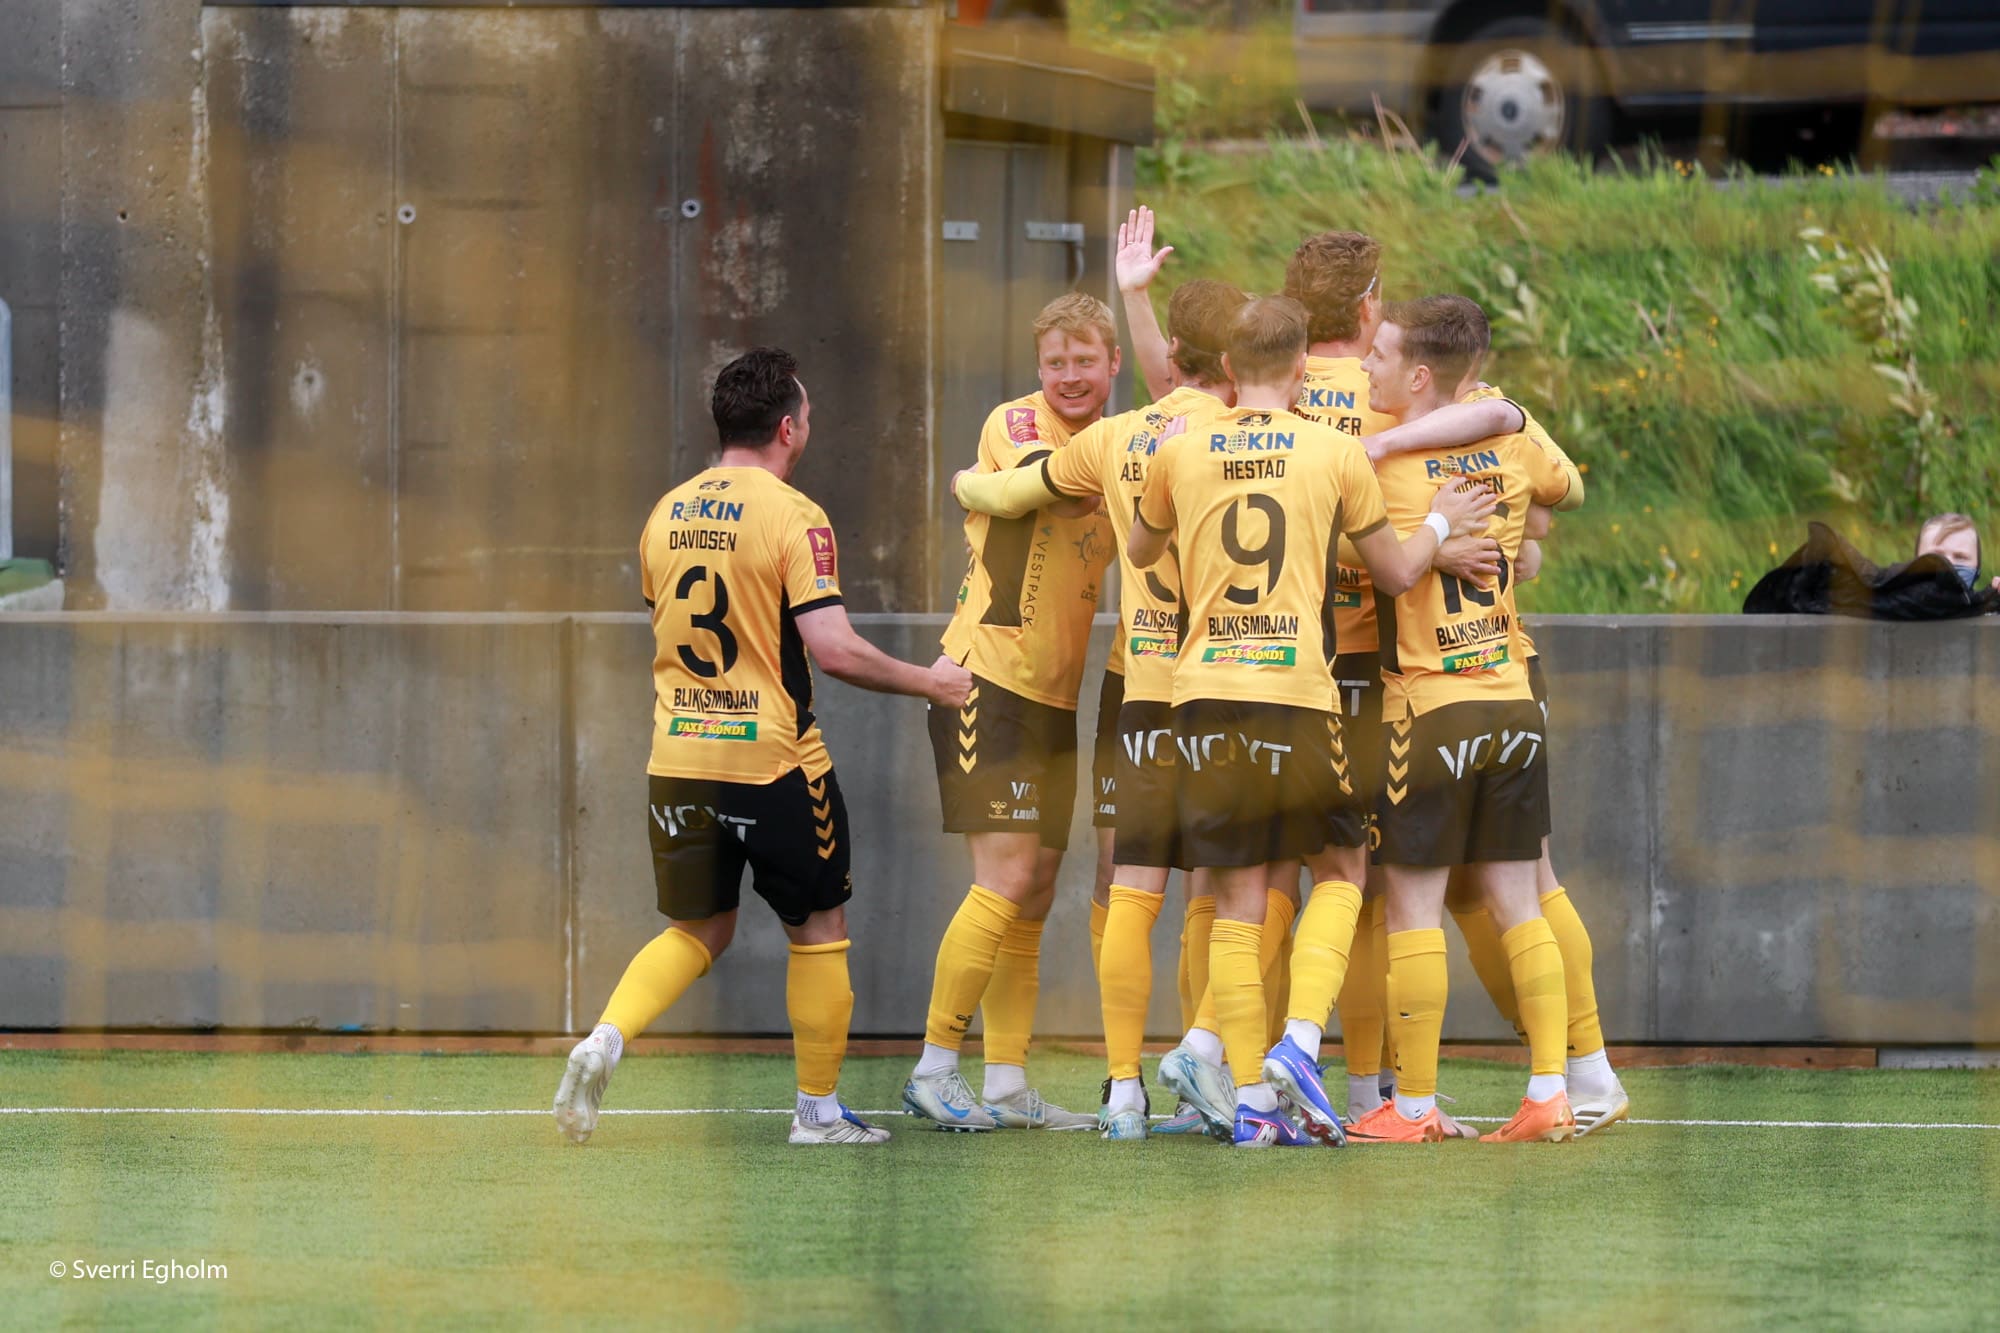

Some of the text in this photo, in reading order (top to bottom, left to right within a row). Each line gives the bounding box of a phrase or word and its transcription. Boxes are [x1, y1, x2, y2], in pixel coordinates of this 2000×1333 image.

[1223, 459, 1286, 481] HESTAD
[669, 529, 737, 552] DAVIDSEN
[1220, 492, 1287, 606] 9
[1022, 540, 1049, 627] VESTPACK
[675, 565, 739, 678] 3
[1245, 649, 1286, 661] KONDI
[1453, 655, 1487, 670] FAXE
[676, 721, 747, 736] FAXE KONDI
